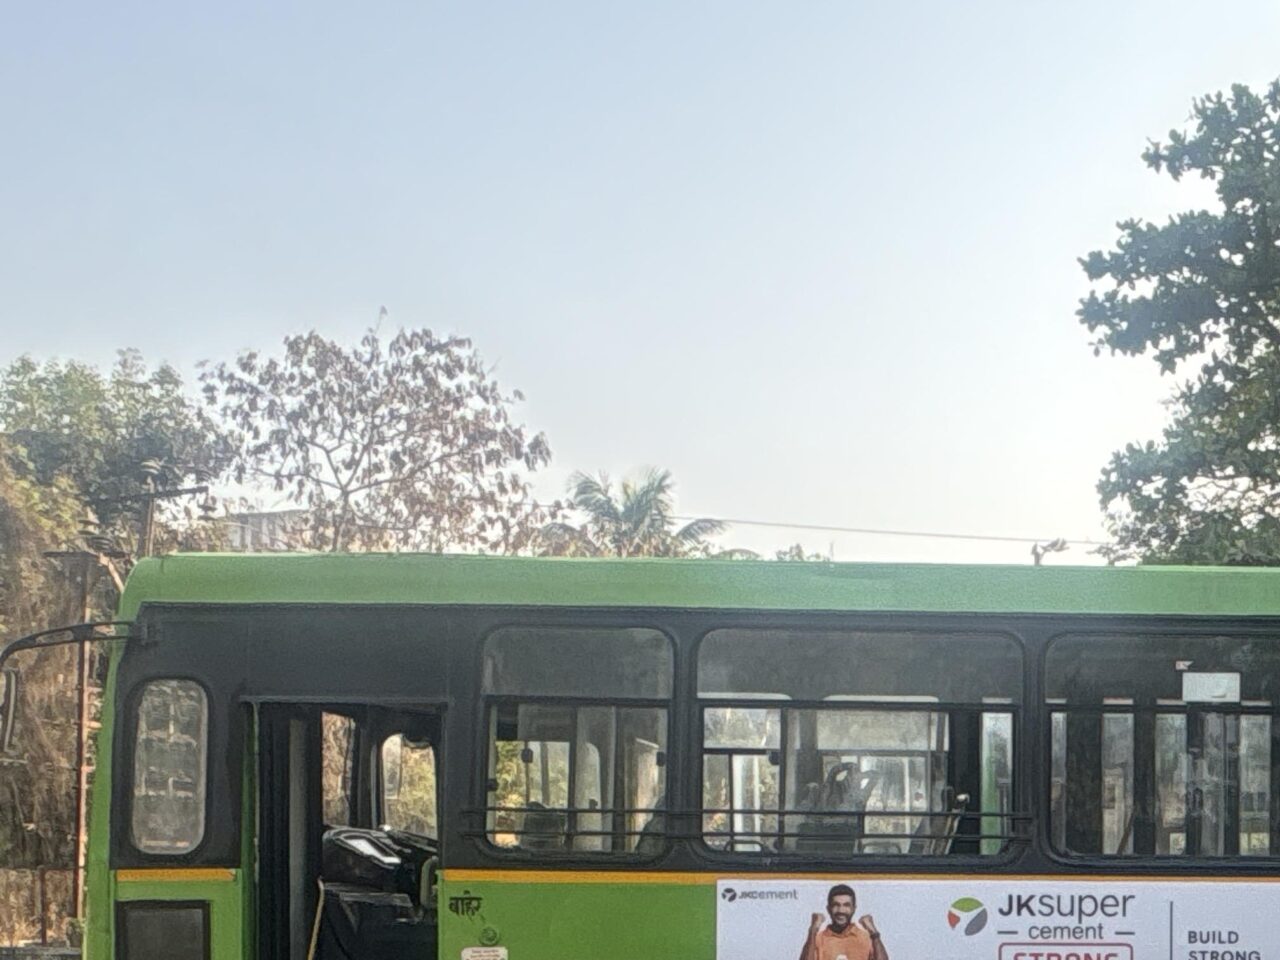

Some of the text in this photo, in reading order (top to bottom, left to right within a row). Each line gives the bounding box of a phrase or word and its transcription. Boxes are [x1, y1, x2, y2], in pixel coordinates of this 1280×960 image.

[998, 894, 1136, 924] JKsuper
[1028, 923, 1104, 940] cement
[1188, 931, 1240, 945] BUILD
